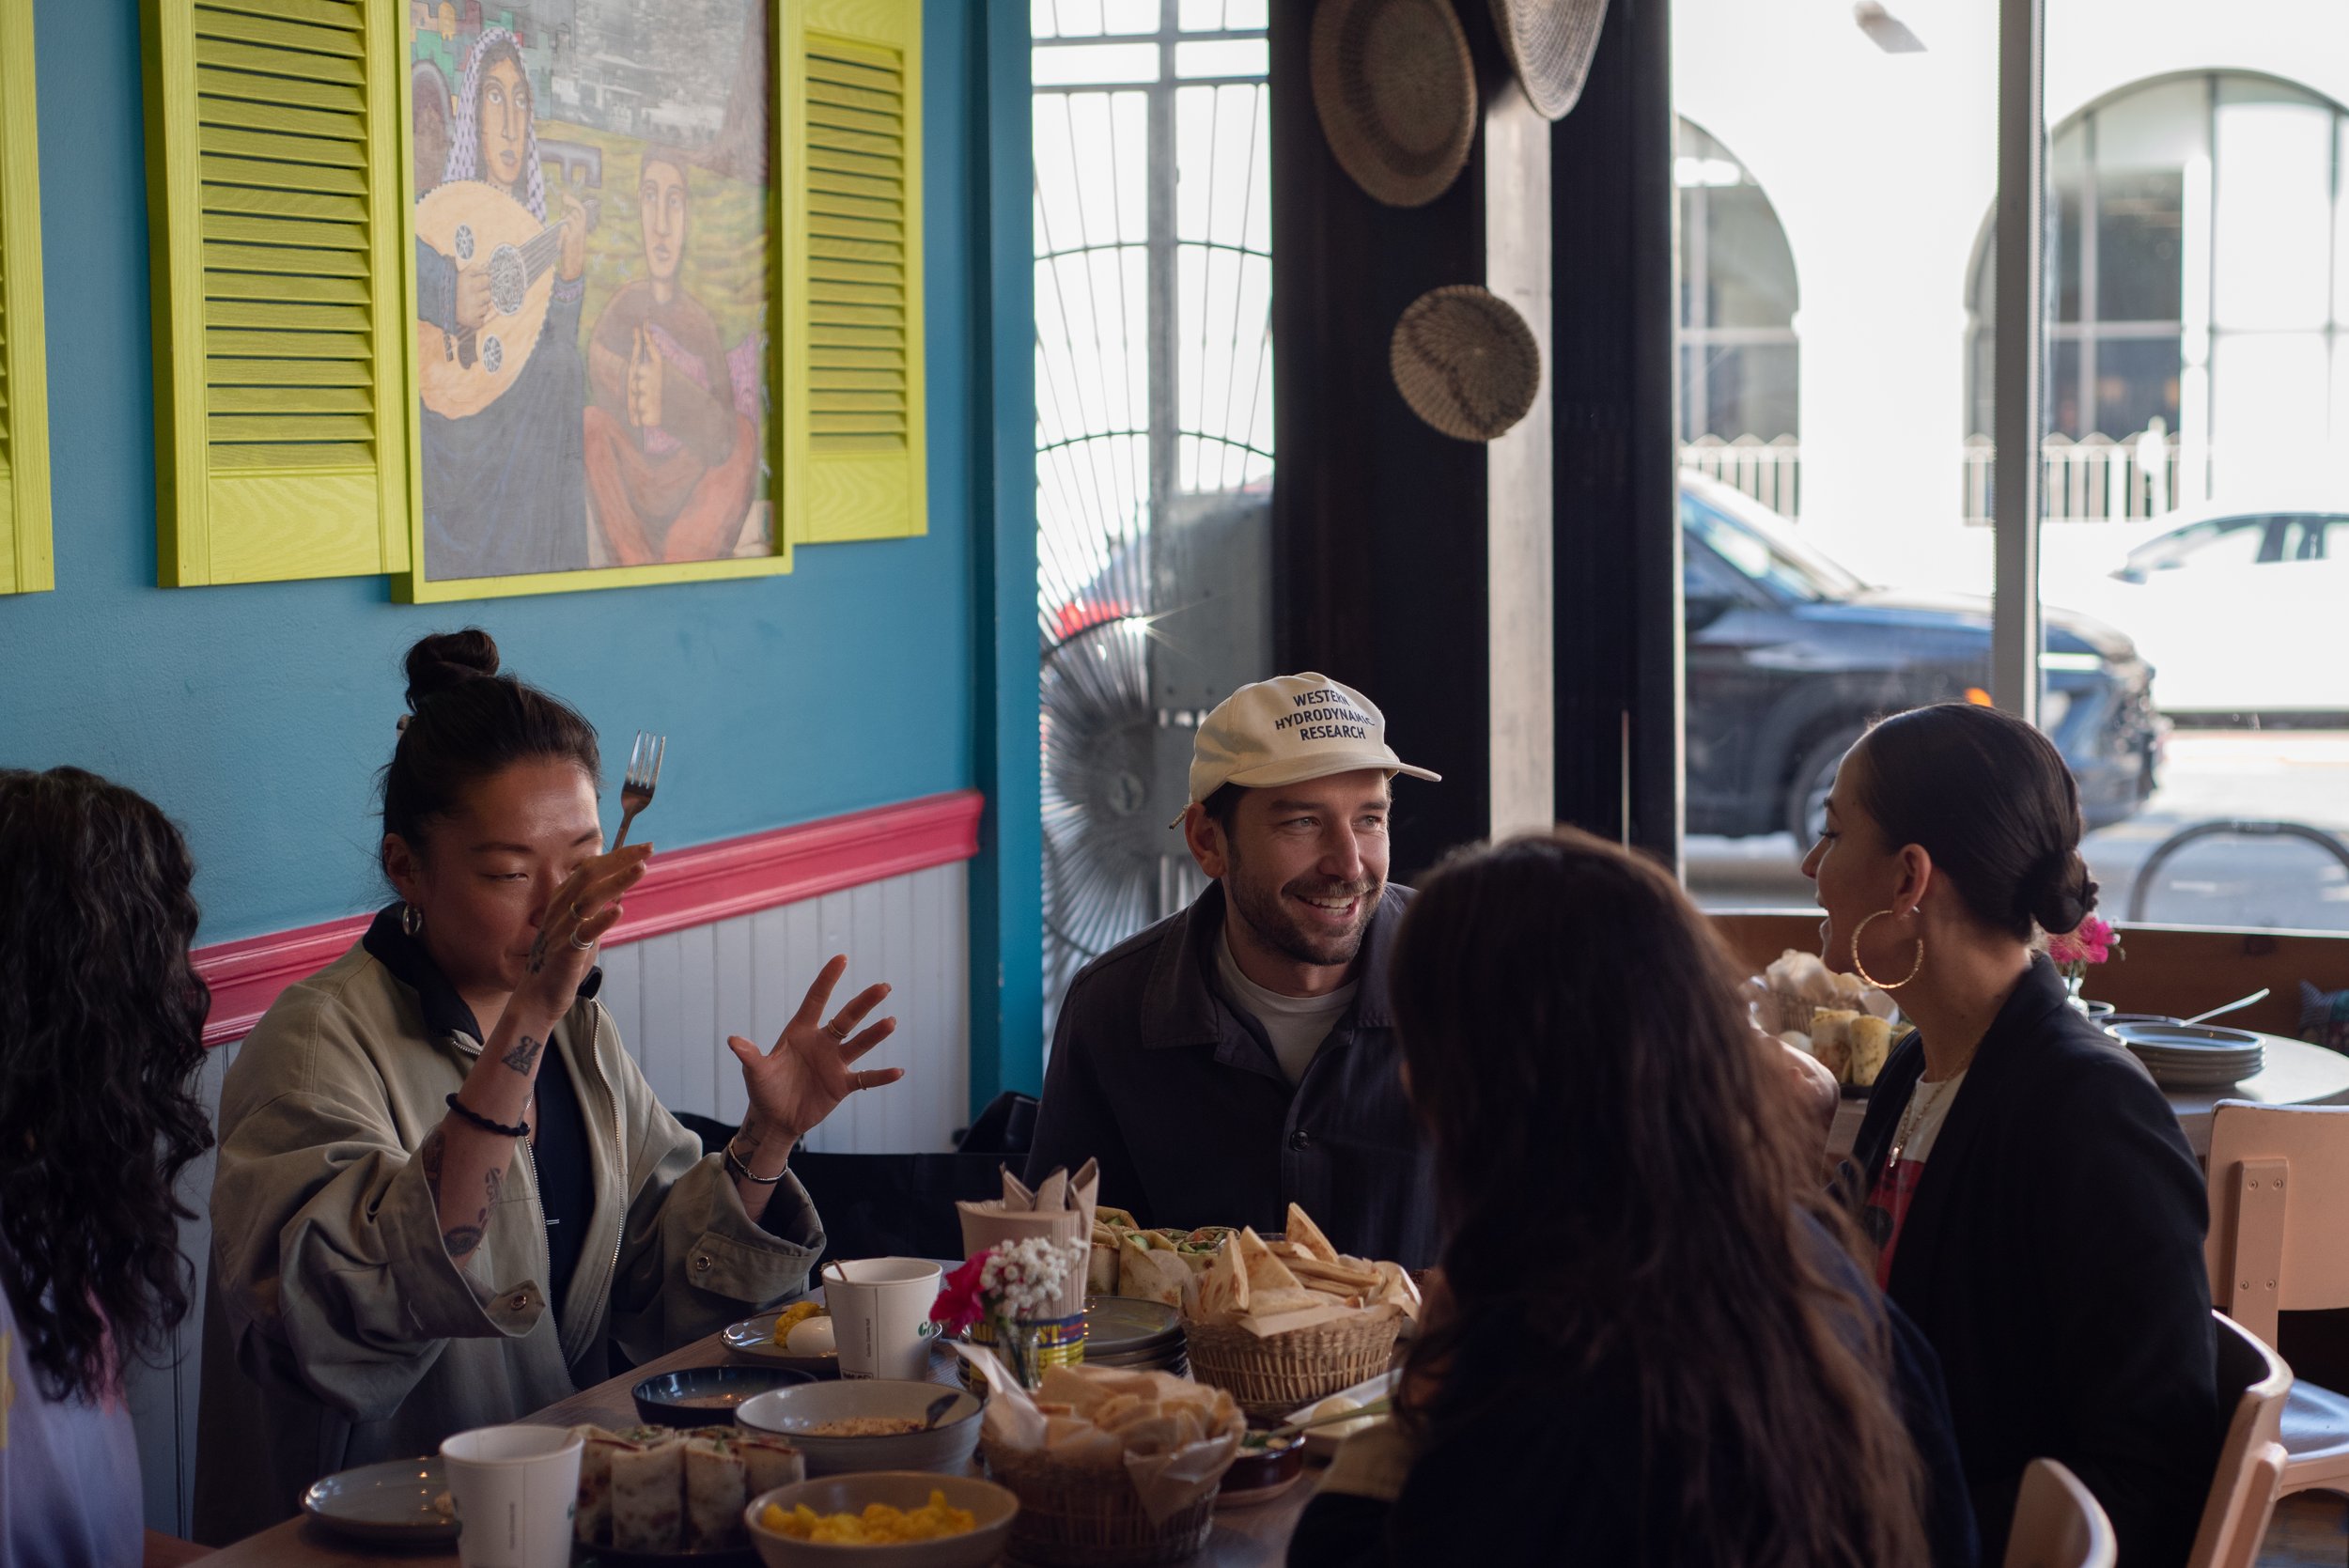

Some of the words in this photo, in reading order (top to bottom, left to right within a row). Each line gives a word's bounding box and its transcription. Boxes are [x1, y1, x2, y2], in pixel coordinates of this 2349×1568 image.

[1293, 690, 1350, 706] WESTERN
[1275, 707, 1375, 730] HYDRODYNAMIC
[1299, 724, 1366, 740] RESEARCH
